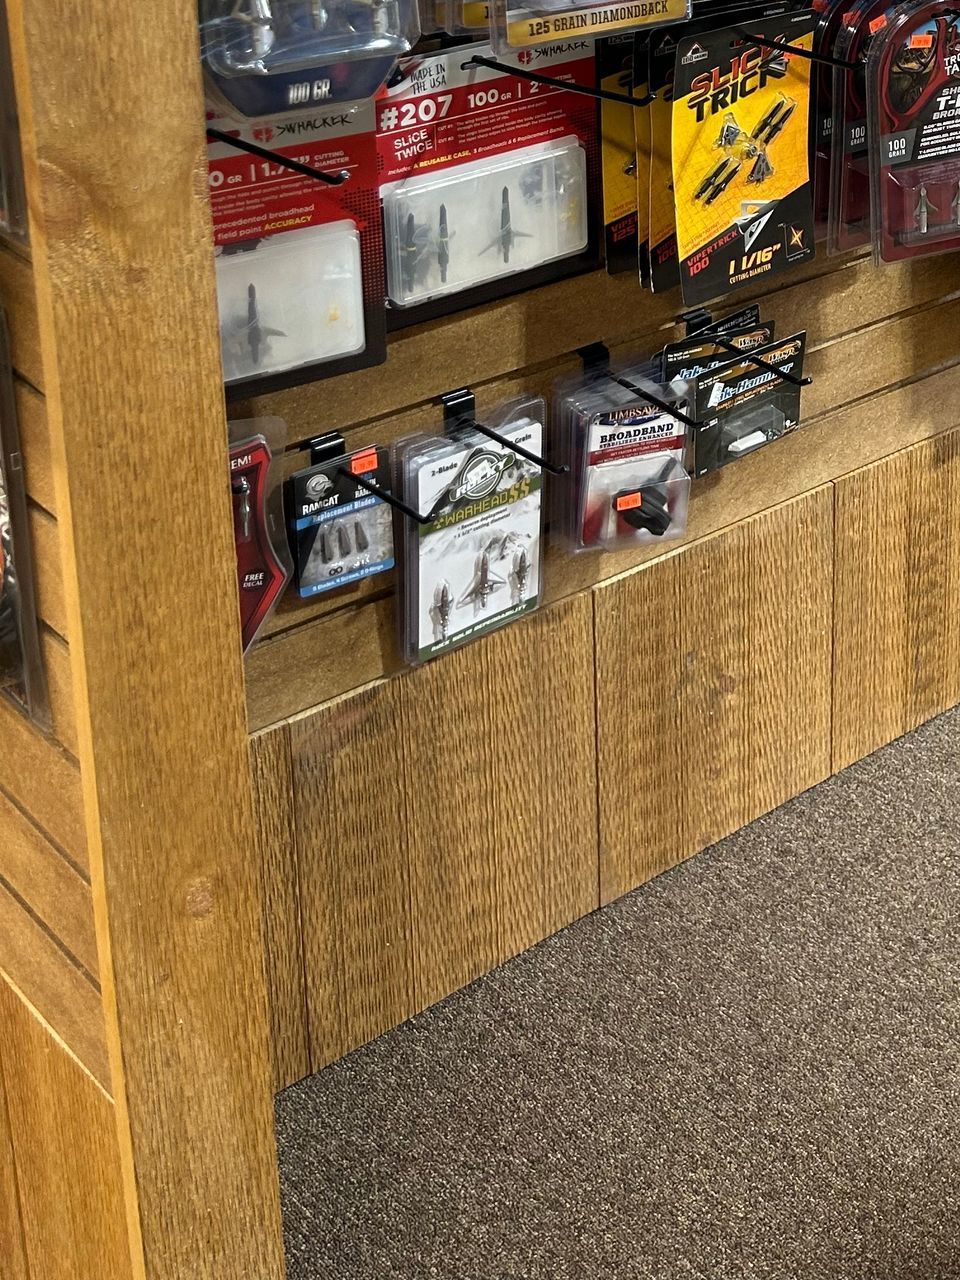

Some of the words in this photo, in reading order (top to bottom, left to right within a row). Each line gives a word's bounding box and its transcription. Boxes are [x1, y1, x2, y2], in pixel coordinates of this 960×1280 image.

[528, 21, 550, 37] 125
[553, 14, 587, 32] GRAIN
[591, 0, 668, 26] DIAMONDBACK
[410, 66, 431, 83] MADE
[435, 63, 446, 75] IN
[288, 84, 310, 105] 100
[312, 78, 332, 99] GR.
[410, 82, 426, 95] THE
[429, 76, 447, 90] USA
[687, 61, 786, 123] TRICK
[380, 94, 453, 131] #207
[468, 88, 499, 109] 100
[501, 91, 512, 101] GR
[394, 129, 428, 150] SLiCE
[850, 126, 866, 138] 100
[394, 139, 433, 161] TWICE
[888, 138, 906, 151] 100
[889, 150, 906, 158] GRAIN
[314, 150, 344, 161] CUTTING
[314, 156, 349, 168] DIAMETER
[268, 204, 315, 220] broadhead
[218, 230, 238, 241] field
[239, 226, 263, 238] point
[264, 215, 313, 231] ACCURACY
[613, 224, 635, 243] 125
[687, 229, 739, 267] VIPERTRICK
[689, 257, 710, 277] 100
[729, 273, 749, 285] CUTTING
[748, 262, 772, 278] DIAMETER
[600, 422, 674, 444] BROADBAND
[638, 431, 674, 442] ENHANCER
[431, 462, 458, 477] 2-Blade
[514, 433, 531, 444] Grain
[302, 494, 340, 516] RAMCAT
[313, 505, 353, 523] Replacement
[354, 497, 376, 510] Blades
[444, 491, 508, 526] WARHEAD
[243, 580, 263, 588] DECAL
[245, 573, 264, 581] FREE
